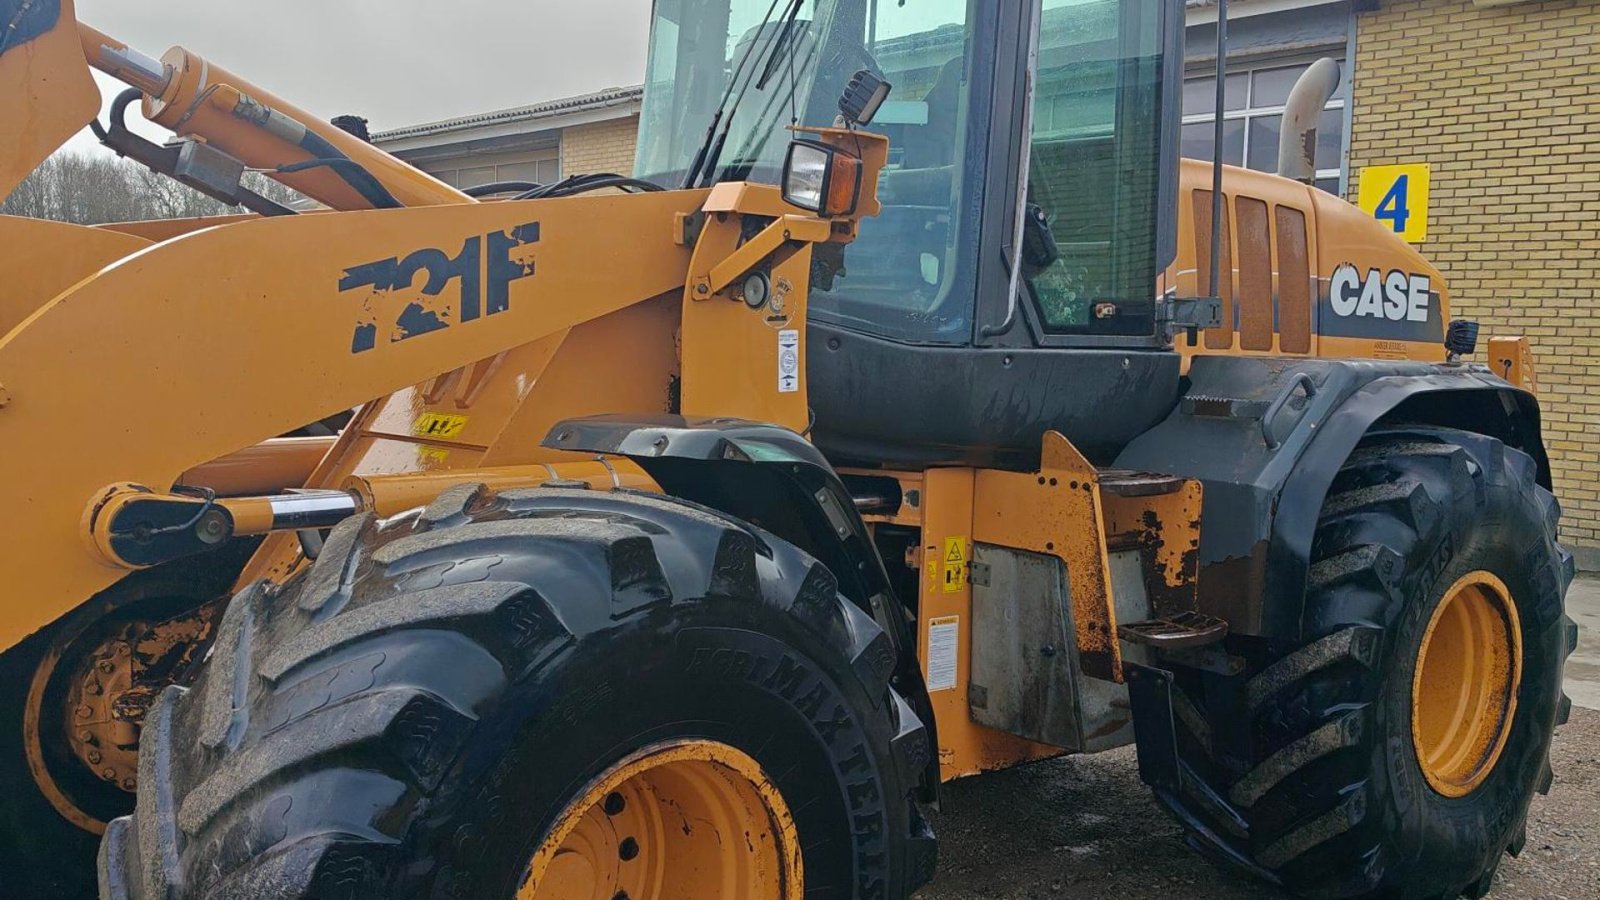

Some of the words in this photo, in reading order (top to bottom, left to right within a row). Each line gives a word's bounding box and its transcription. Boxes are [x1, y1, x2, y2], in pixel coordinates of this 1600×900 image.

[1374, 174, 1410, 233] 4
[338, 221, 541, 354] 721F
[1330, 263, 1430, 322] CASE
